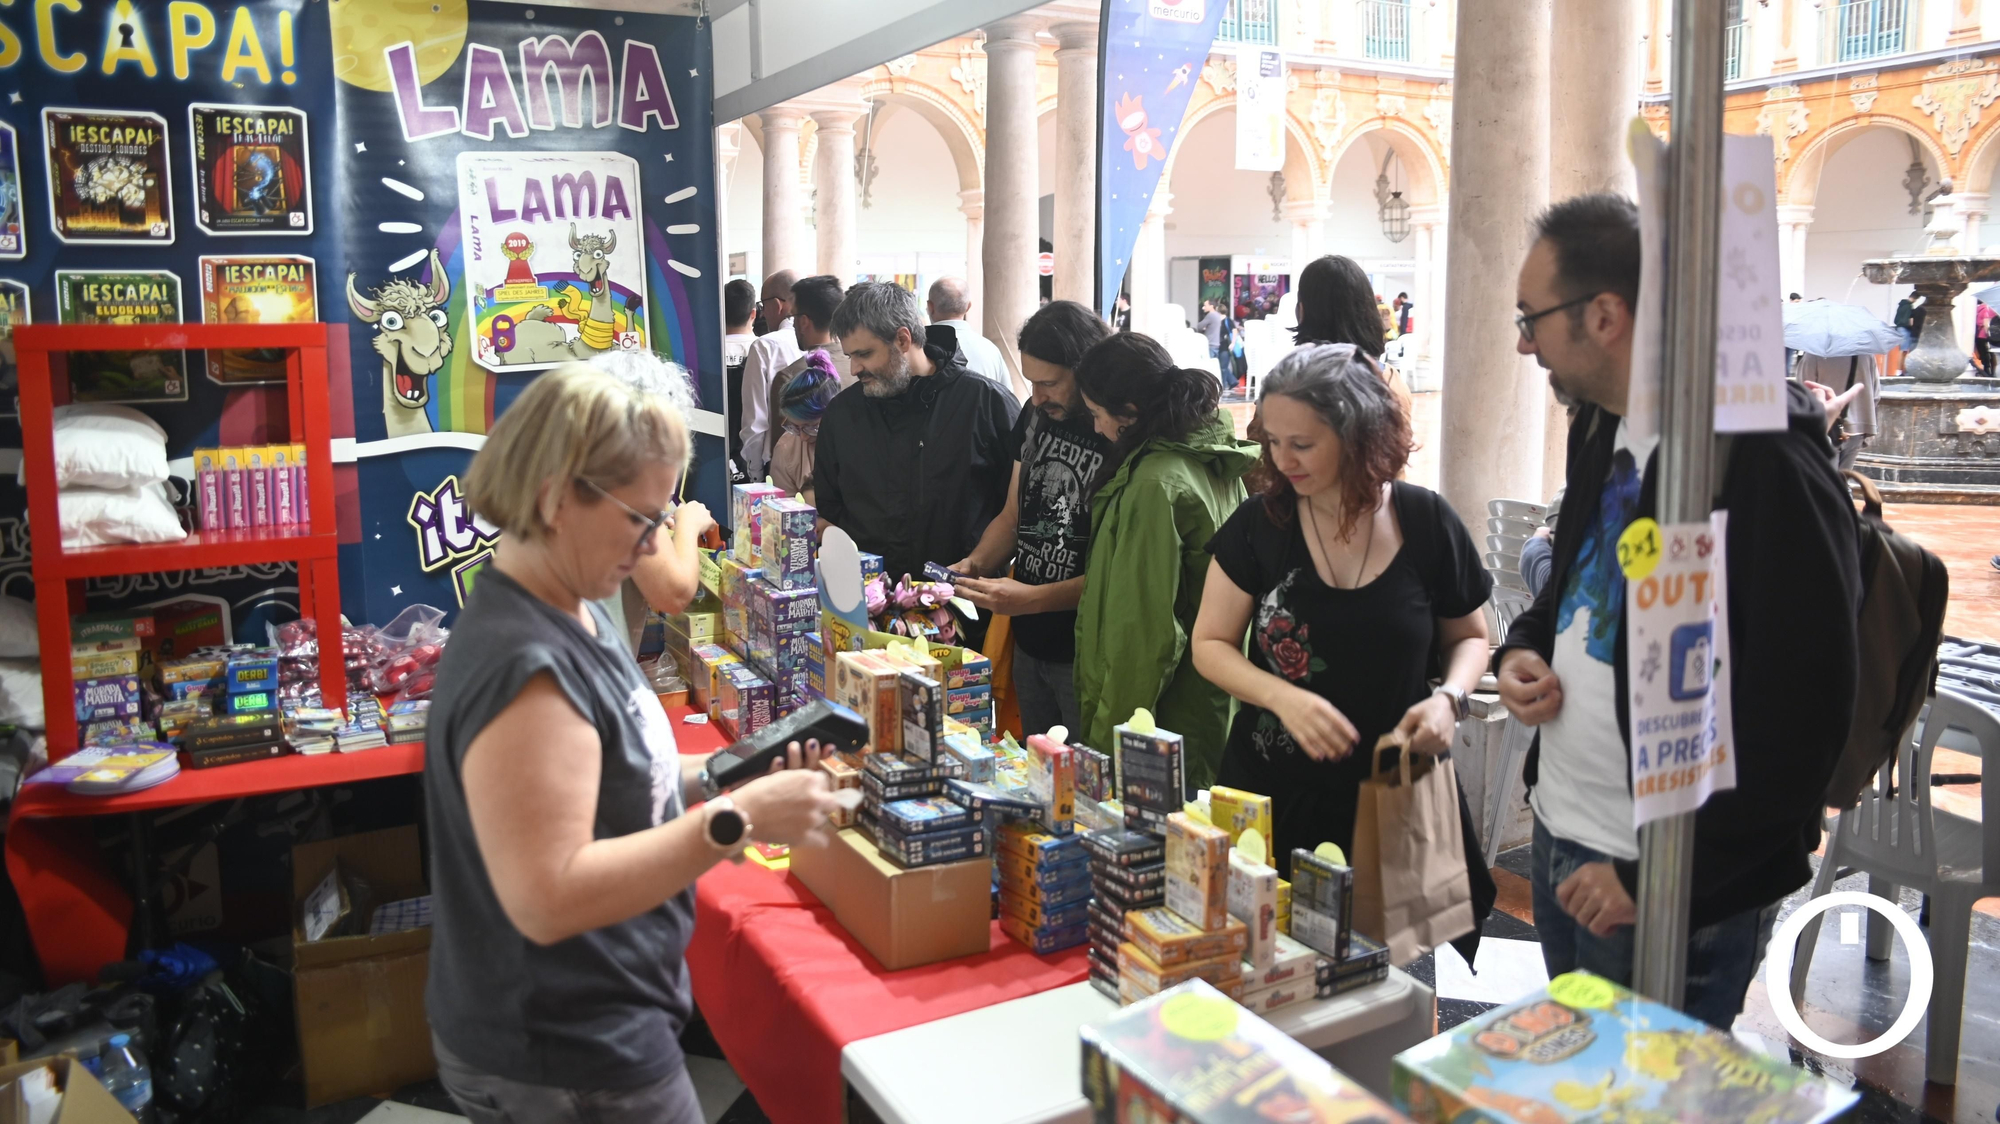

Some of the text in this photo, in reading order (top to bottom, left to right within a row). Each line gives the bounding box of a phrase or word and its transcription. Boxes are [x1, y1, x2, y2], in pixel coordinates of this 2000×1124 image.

[1153, 6, 1200, 20] mercurio
[384, 30, 680, 142] LAMA
[484, 170, 633, 226] LAMA
[470, 214, 482, 261] LAMA
[508, 239, 527, 248] 2019
[225, 264, 305, 283] ¡ESCAPA!
[83, 284, 168, 302] ¡ESCAPA!
[1040, 541, 1078, 567] RIDE
[1025, 554, 1042, 577] OR
[928, 649, 951, 657] arro
[1123, 736, 1147, 750] The Mind
[1172, 768, 1180, 788] Mind
[1130, 847, 1160, 862] The Mind
